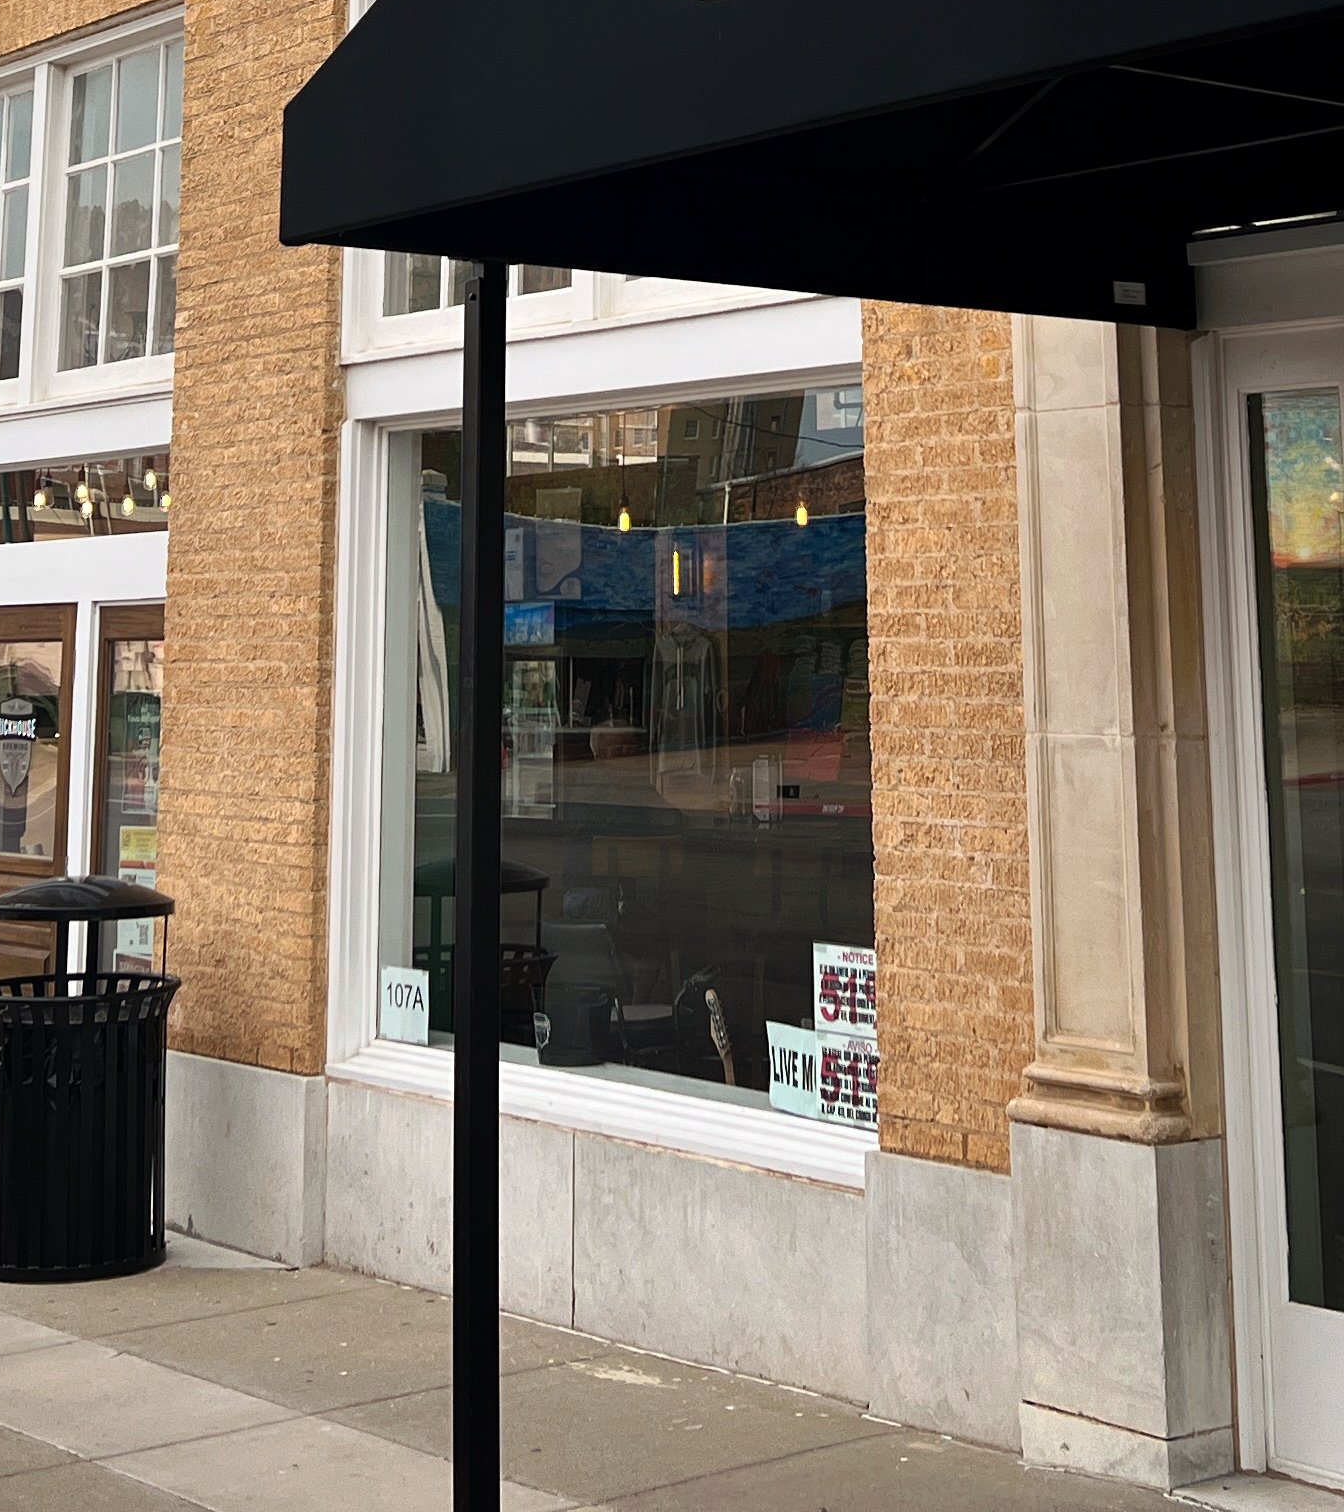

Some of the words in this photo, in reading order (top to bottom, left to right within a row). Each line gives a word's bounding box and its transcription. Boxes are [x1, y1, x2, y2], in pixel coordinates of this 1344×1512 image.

[842, 951, 874, 966] NOTICE
[386, 981, 425, 1013] 107A
[847, 1040, 873, 1055] AVISO
[771, 1045, 799, 1089] LIVE
